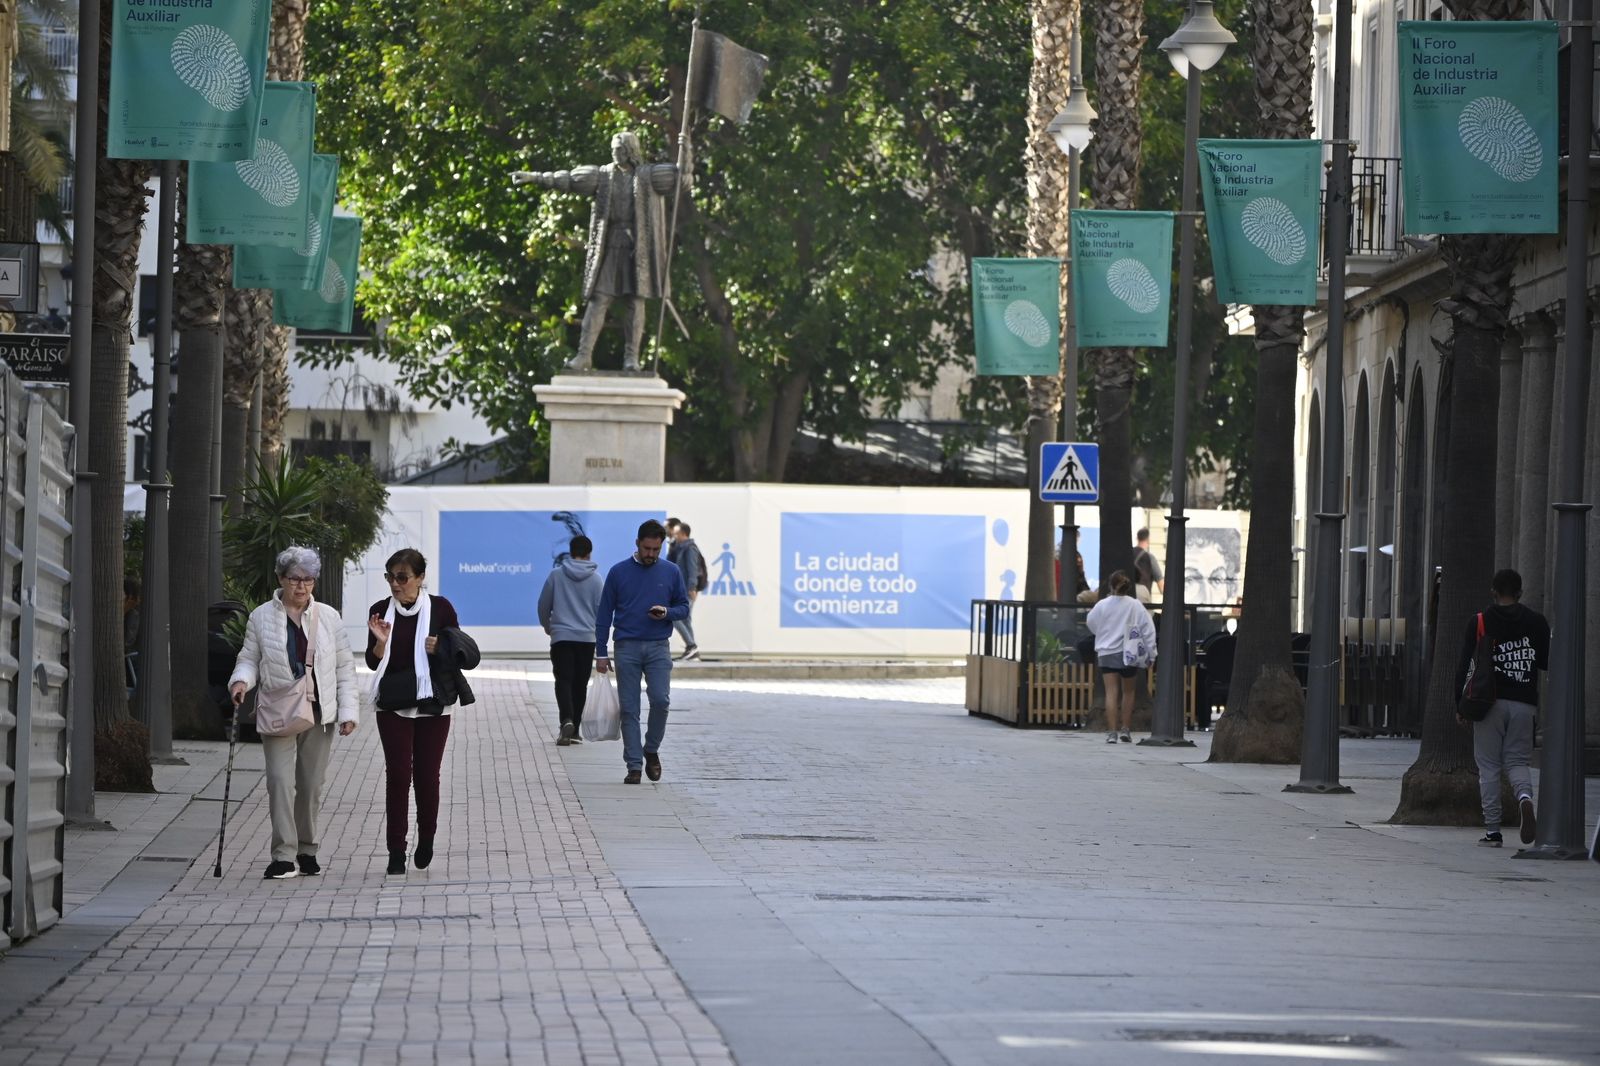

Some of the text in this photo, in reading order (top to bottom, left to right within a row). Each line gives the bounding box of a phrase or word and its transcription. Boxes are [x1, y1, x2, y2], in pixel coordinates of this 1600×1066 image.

[126, 9, 180, 22] Auxiliar
[1412, 38, 1456, 50] II Foro
[1412, 52, 1475, 65] Nacional
[1413, 68, 1498, 80] de Industria
[1413, 83, 1466, 96] Auxiliar
[1218, 152, 1242, 161] Foro
[1210, 163, 1256, 172] Nacional
[1225, 175, 1273, 185] Industria
[1093, 240, 1134, 248] Industria
[1080, 249, 1113, 257] Auxiliar
[31, 337, 41, 347] El
[795, 552, 899, 571] La ciudad
[794, 573, 917, 593] donde todo
[794, 594, 899, 614] comienza
[1498, 636, 1531, 652] YOUR
[1504, 660, 1531, 671] ONLY
